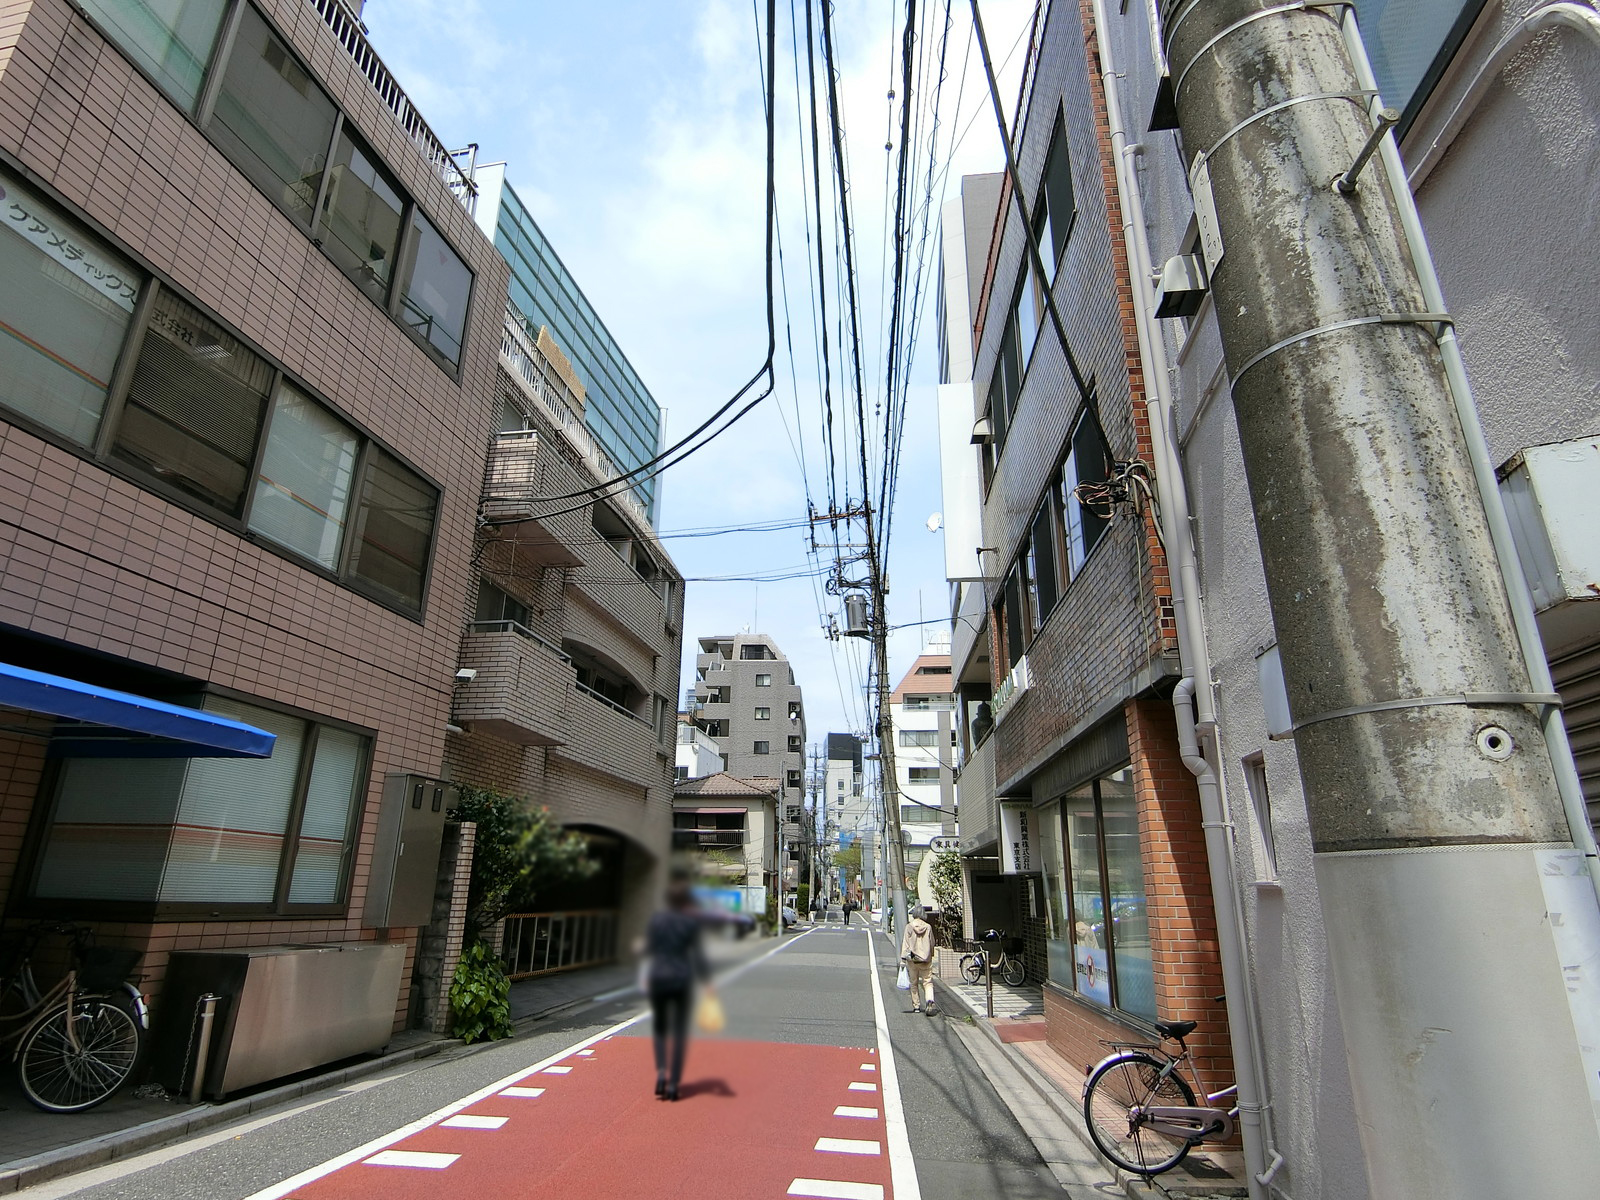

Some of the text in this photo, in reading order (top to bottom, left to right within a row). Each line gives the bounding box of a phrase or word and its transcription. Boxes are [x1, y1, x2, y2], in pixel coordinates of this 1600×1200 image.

[9, 204, 136, 306] ケアメディックス
[1013, 842, 1022, 870] 東京支店
